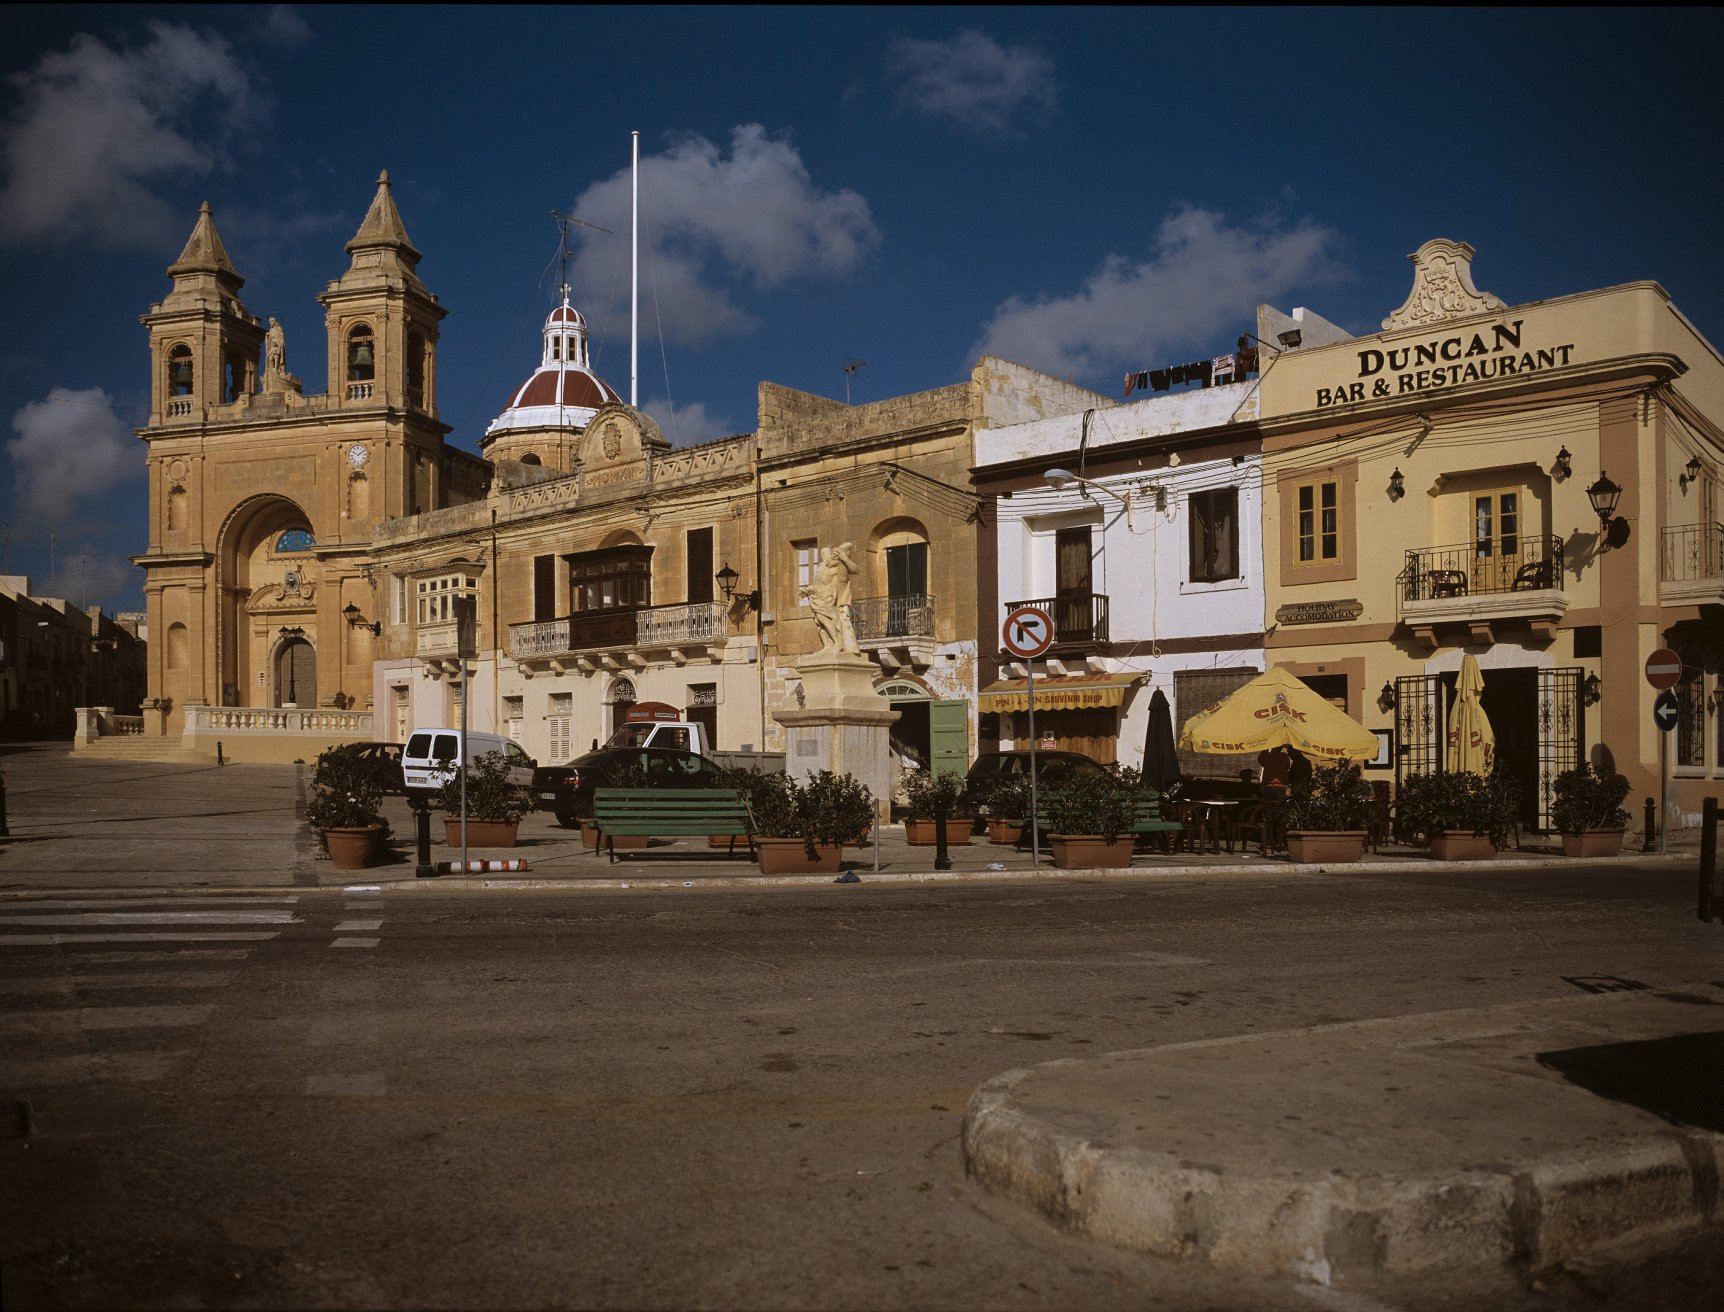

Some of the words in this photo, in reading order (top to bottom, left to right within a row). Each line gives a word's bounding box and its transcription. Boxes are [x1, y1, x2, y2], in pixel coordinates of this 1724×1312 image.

[1357, 320, 1524, 378] DUNCAN
[1316, 382, 1366, 407] BAR
[1372, 378, 1391, 398] &
[1398, 344, 1575, 394] RESTAURANT
[1297, 603, 1336, 612] HOLIDAY
[1284, 610, 1355, 622] ACCOMODATION
[995, 698, 1010, 707] PIN
[1045, 694, 1080, 704] SOUVENIR
[1083, 694, 1103, 704] SHOP
[1312, 745, 1347, 756] CISK
